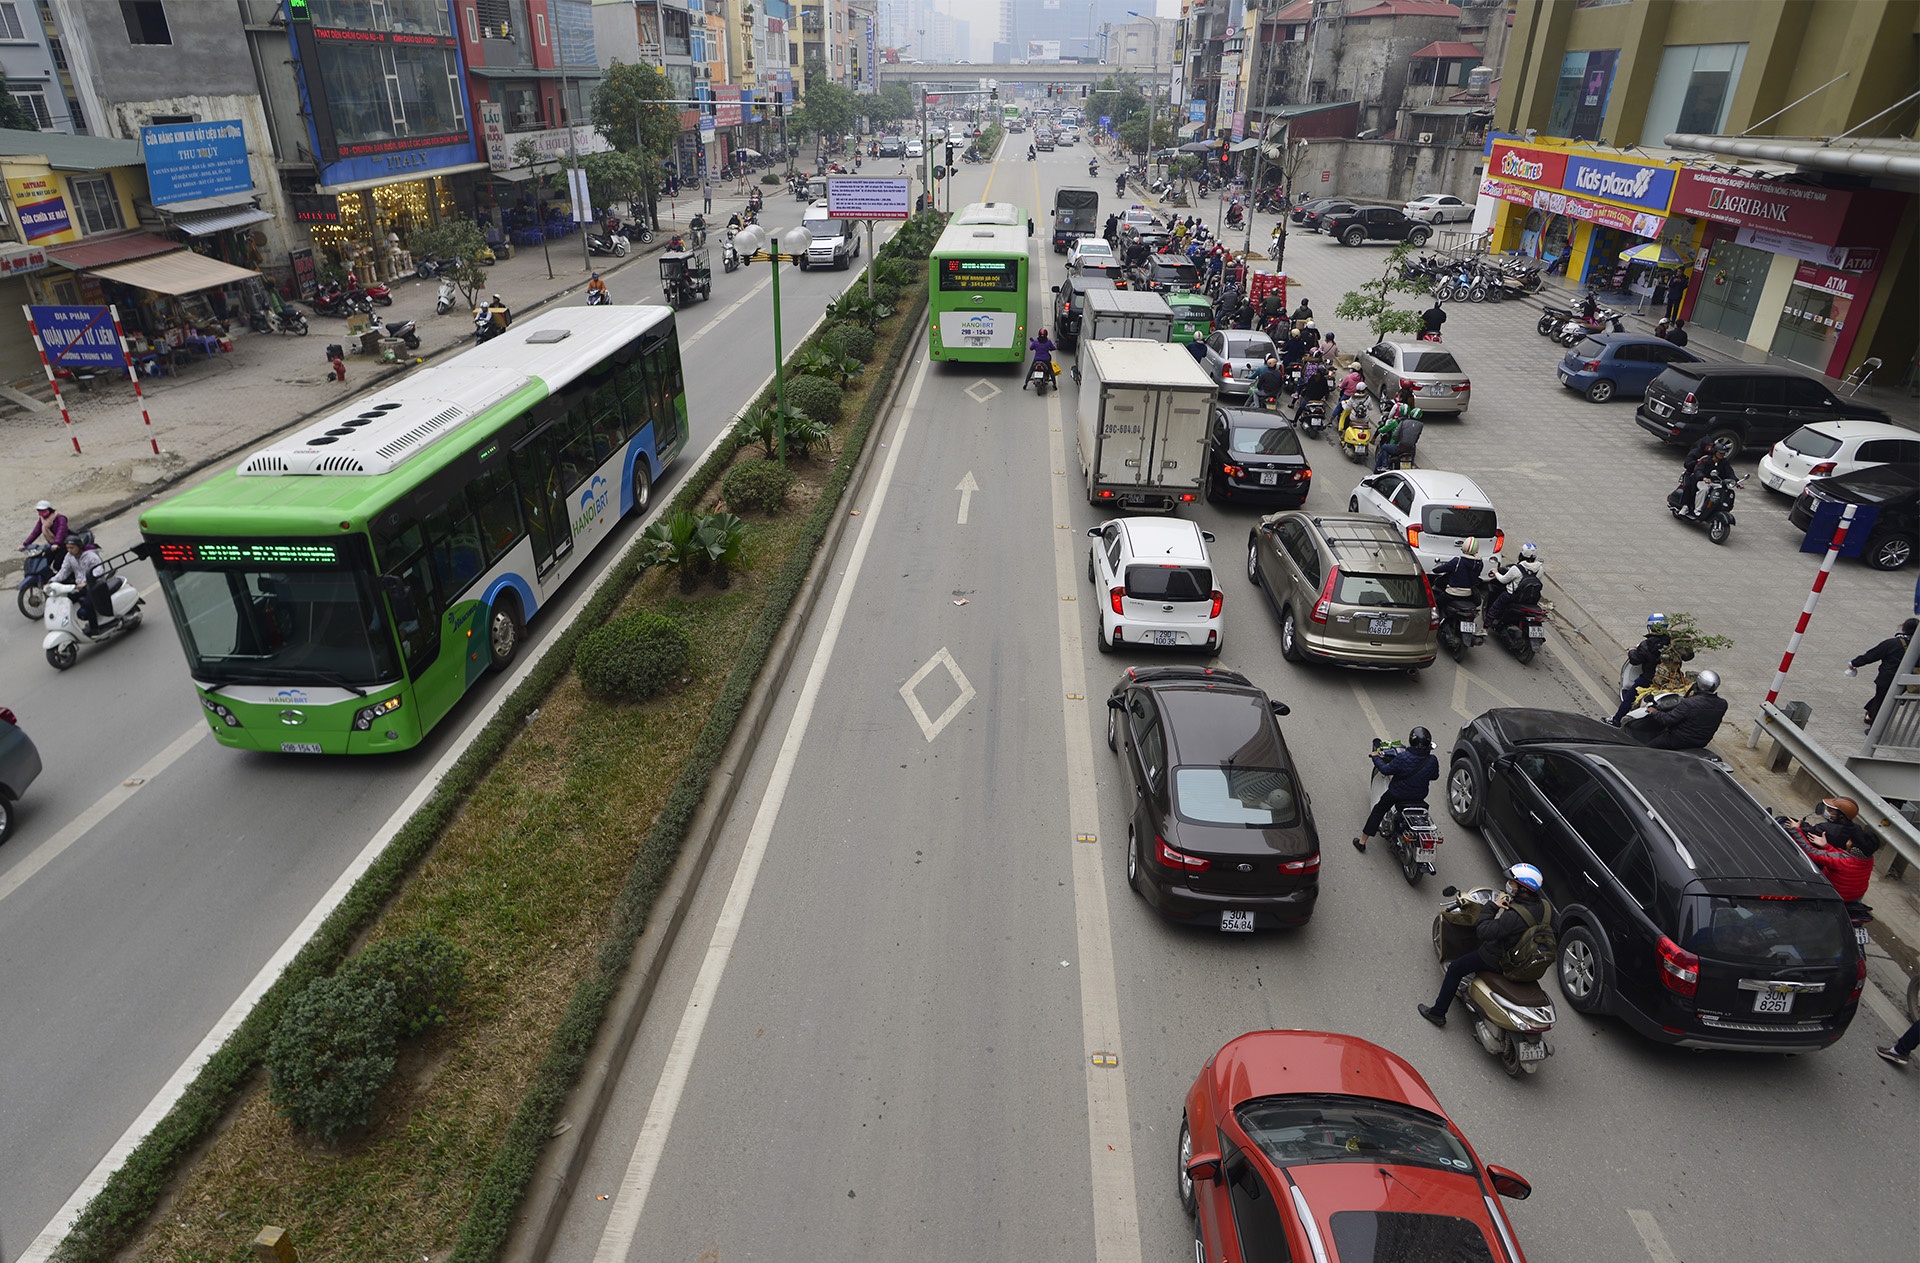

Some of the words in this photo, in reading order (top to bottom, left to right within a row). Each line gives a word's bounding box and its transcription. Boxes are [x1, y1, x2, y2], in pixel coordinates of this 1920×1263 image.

[484, 108, 499, 123] LẨU
[489, 125, 498, 133] BIA
[158, 130, 174, 144] HÀNG
[174, 131, 185, 142] KIM
[178, 148, 196, 160] THU
[386, 152, 428, 169] ITALY
[1576, 166, 1598, 190] Kids
[1600, 170, 1636, 198] plaza
[1720, 195, 1790, 222] AGRIBANK
[33, 211, 48, 223] CHỮA
[48, 211, 56, 220] XE
[56, 208, 67, 220] MÁY
[13, 257, 27, 270] QUY
[1845, 258, 1872, 269] ATM
[1824, 276, 1848, 292] ATM
[54, 312, 68, 322] ĐỊA
[69, 310, 90, 322] PHẬN
[42, 326, 66, 348] QUẬN
[64, 329, 84, 345] NAM
[95, 326, 116, 345] LIÊM
[81, 352, 100, 360] TRUNG
[572, 504, 597, 538] HANOI
[596, 490, 609, 514] BRT
[1230, 911, 1246, 920] 30A
[1222, 920, 1252, 930] 554.84
[1764, 991, 1787, 1000] 30N
[1760, 1001, 1786, 1011] 8251
